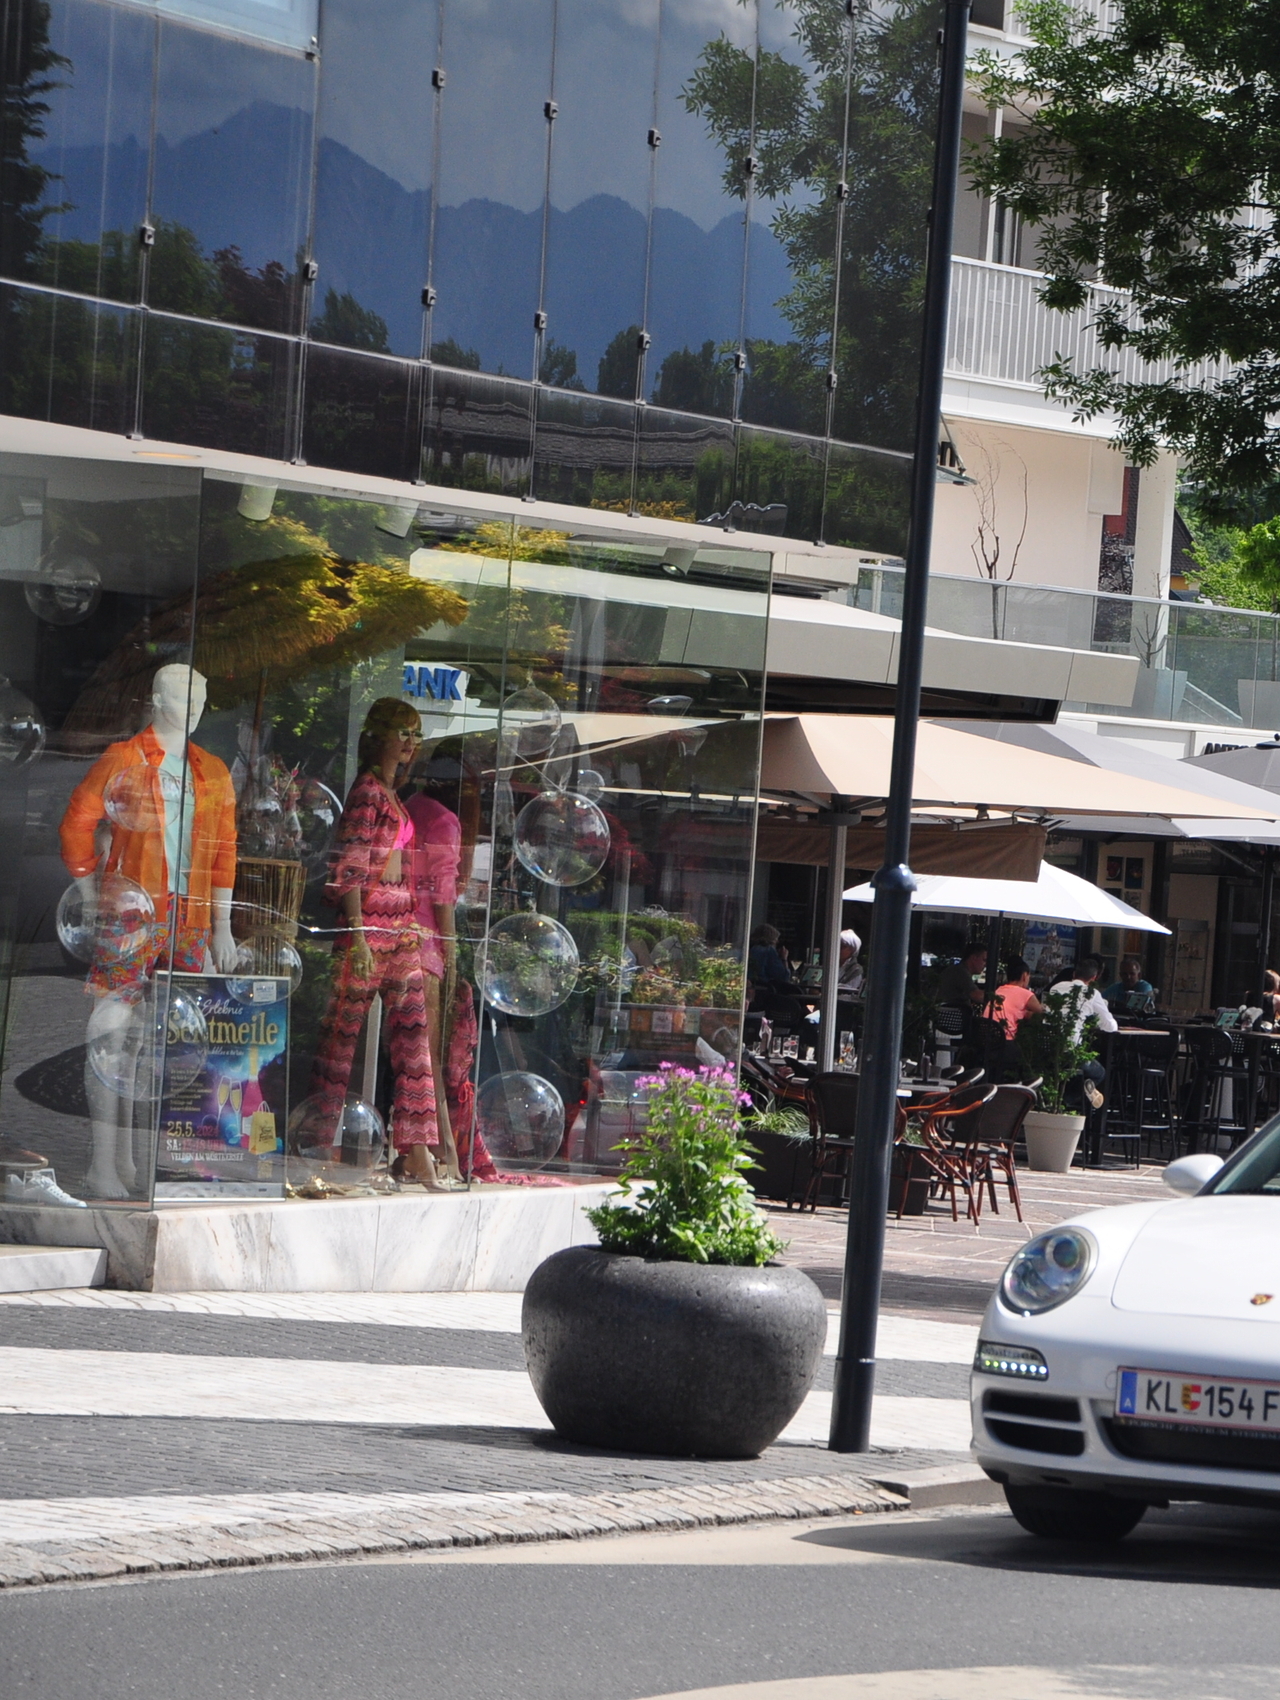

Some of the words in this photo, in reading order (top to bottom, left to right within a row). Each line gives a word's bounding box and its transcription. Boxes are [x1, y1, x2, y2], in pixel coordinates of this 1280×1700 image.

[201, 998, 243, 1018] Erlebnis
[166, 1120, 195, 1138] 25.5.
[166, 1139, 182, 1152] SA:
[1123, 1397, 1132, 1408] A
[1146, 1379, 1177, 1413] KL
[1204, 1385, 1254, 1420] 154
[1128, 1418, 1176, 1431] PORSCHE
[1178, 1423, 1229, 1437] ZENTRUM
